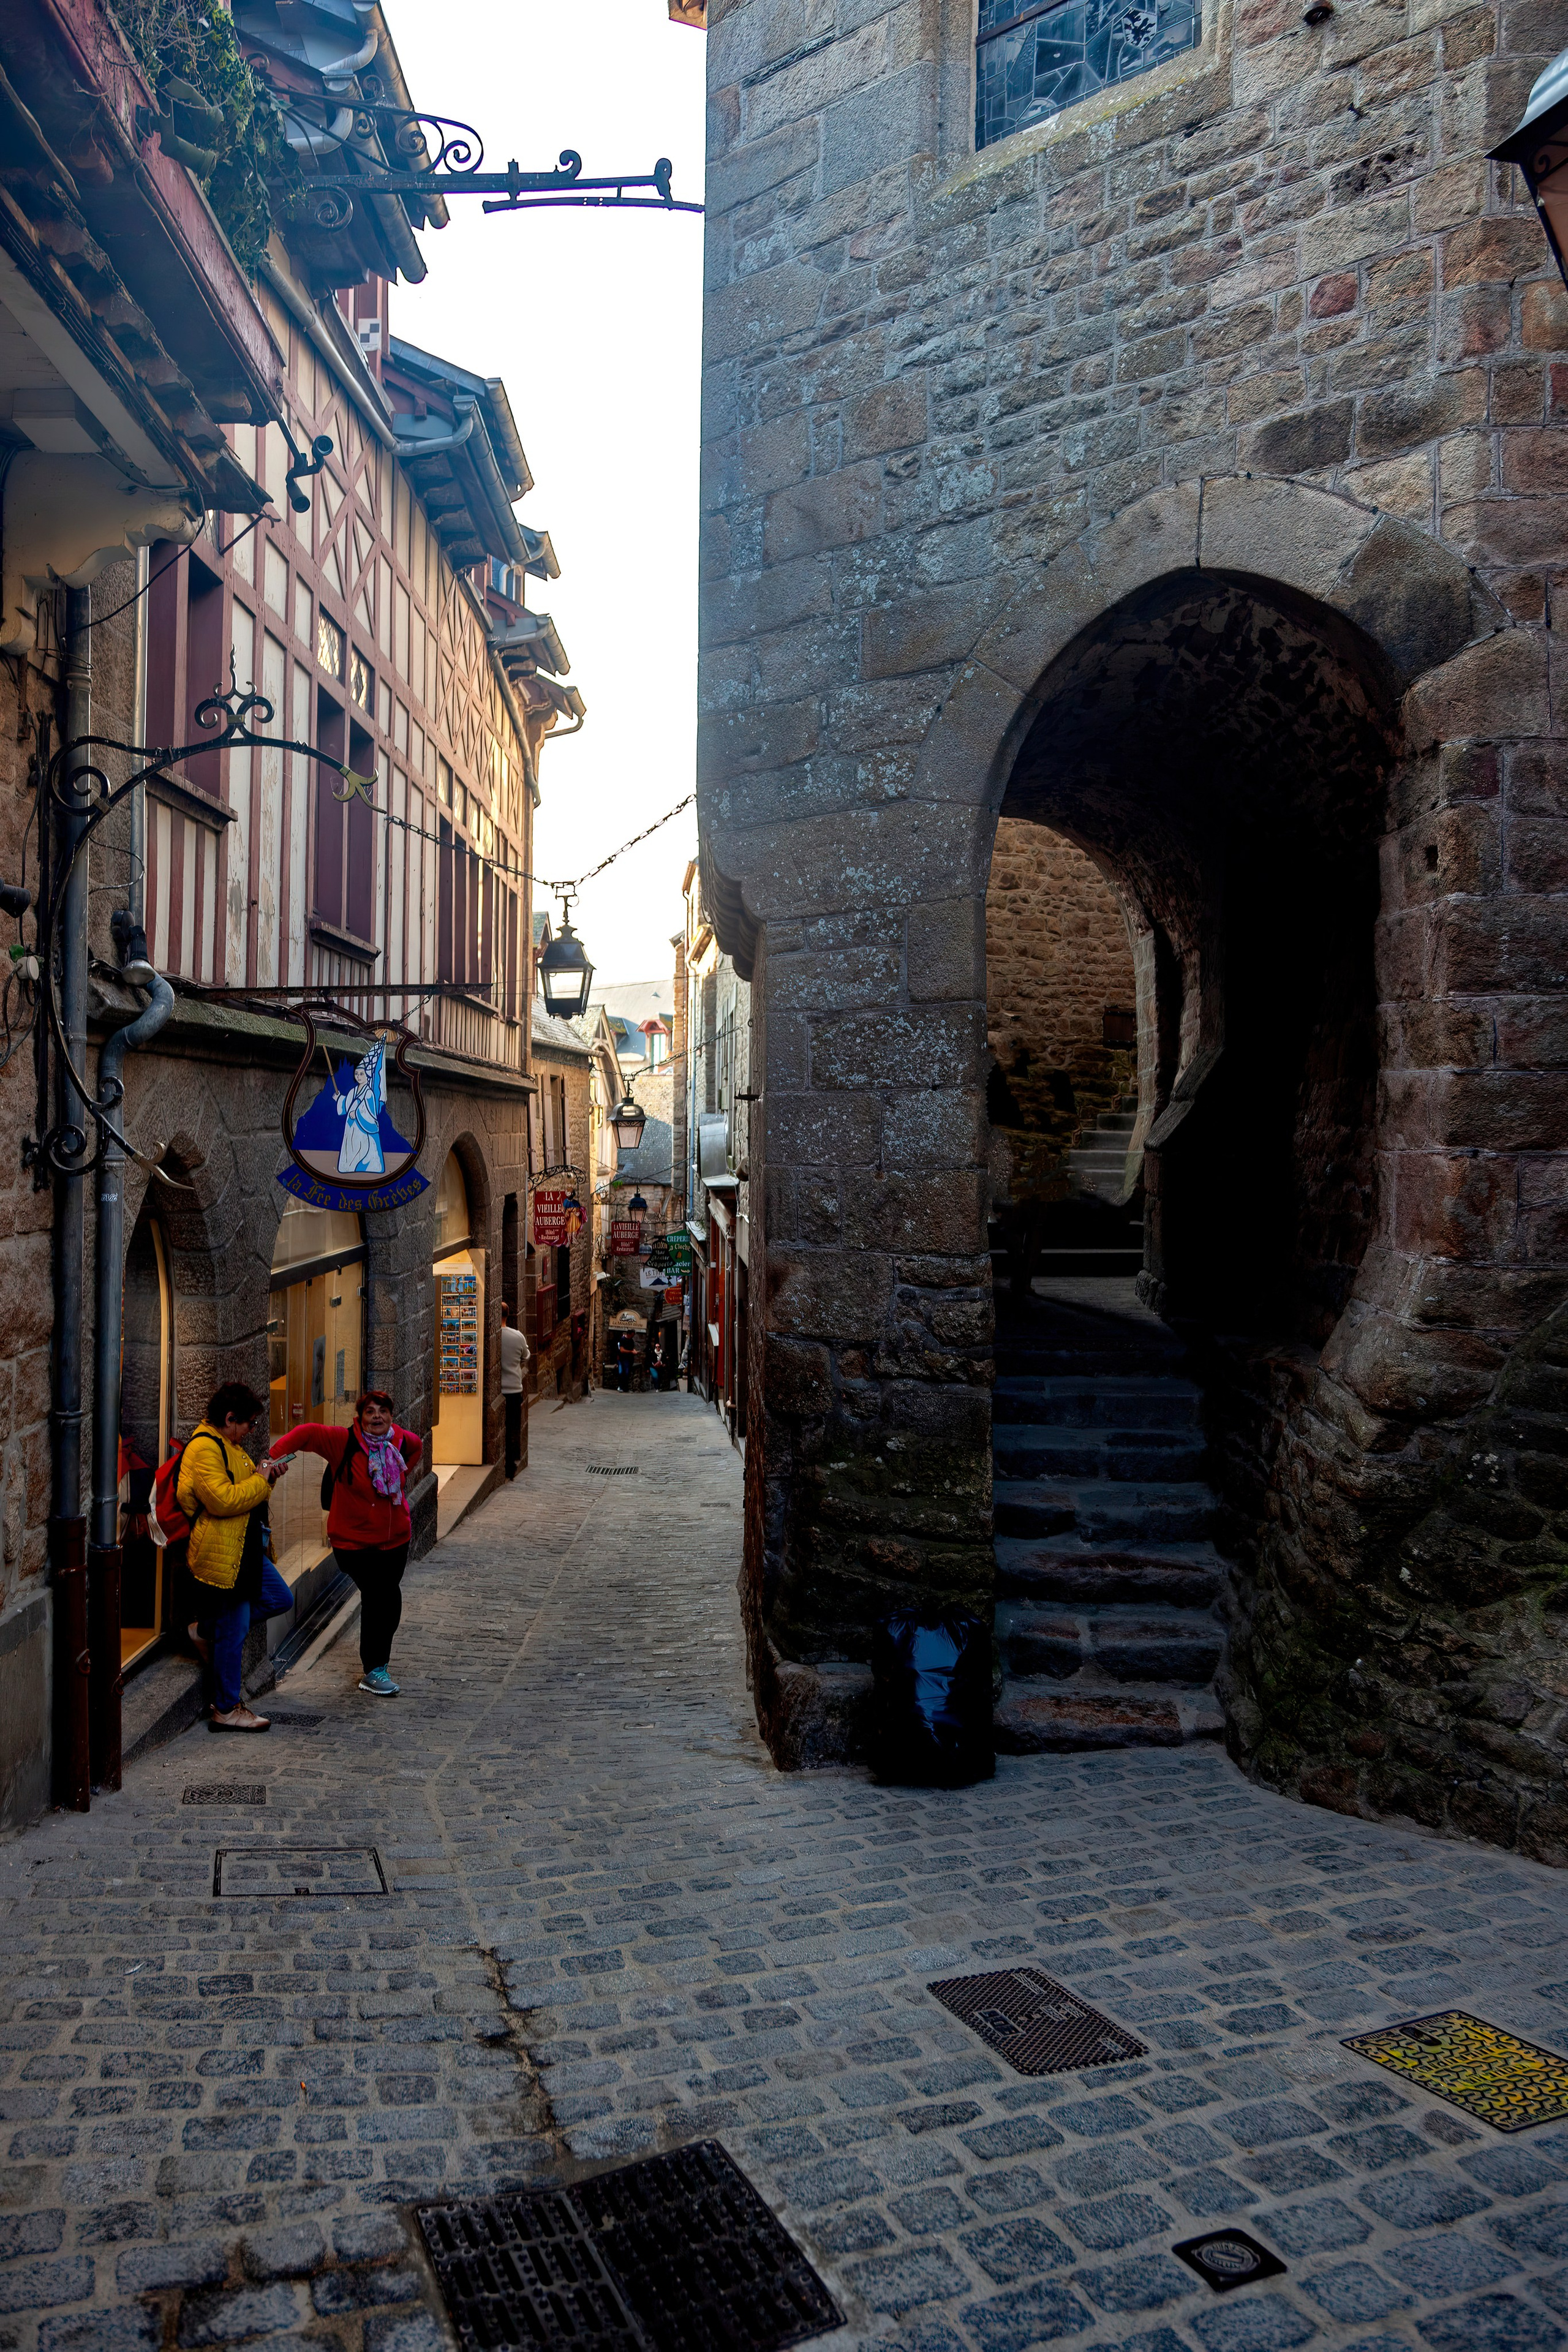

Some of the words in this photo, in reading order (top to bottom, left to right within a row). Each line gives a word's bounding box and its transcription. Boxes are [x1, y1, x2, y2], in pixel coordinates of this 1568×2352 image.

[545, 1191, 554, 1200] LA
[339, 1191, 362, 1210] des
[537, 1204, 564, 1213] VIEILLE
[535, 1216, 565, 1226] AUBERGE
[674, 1243, 691, 1252] Cloche
